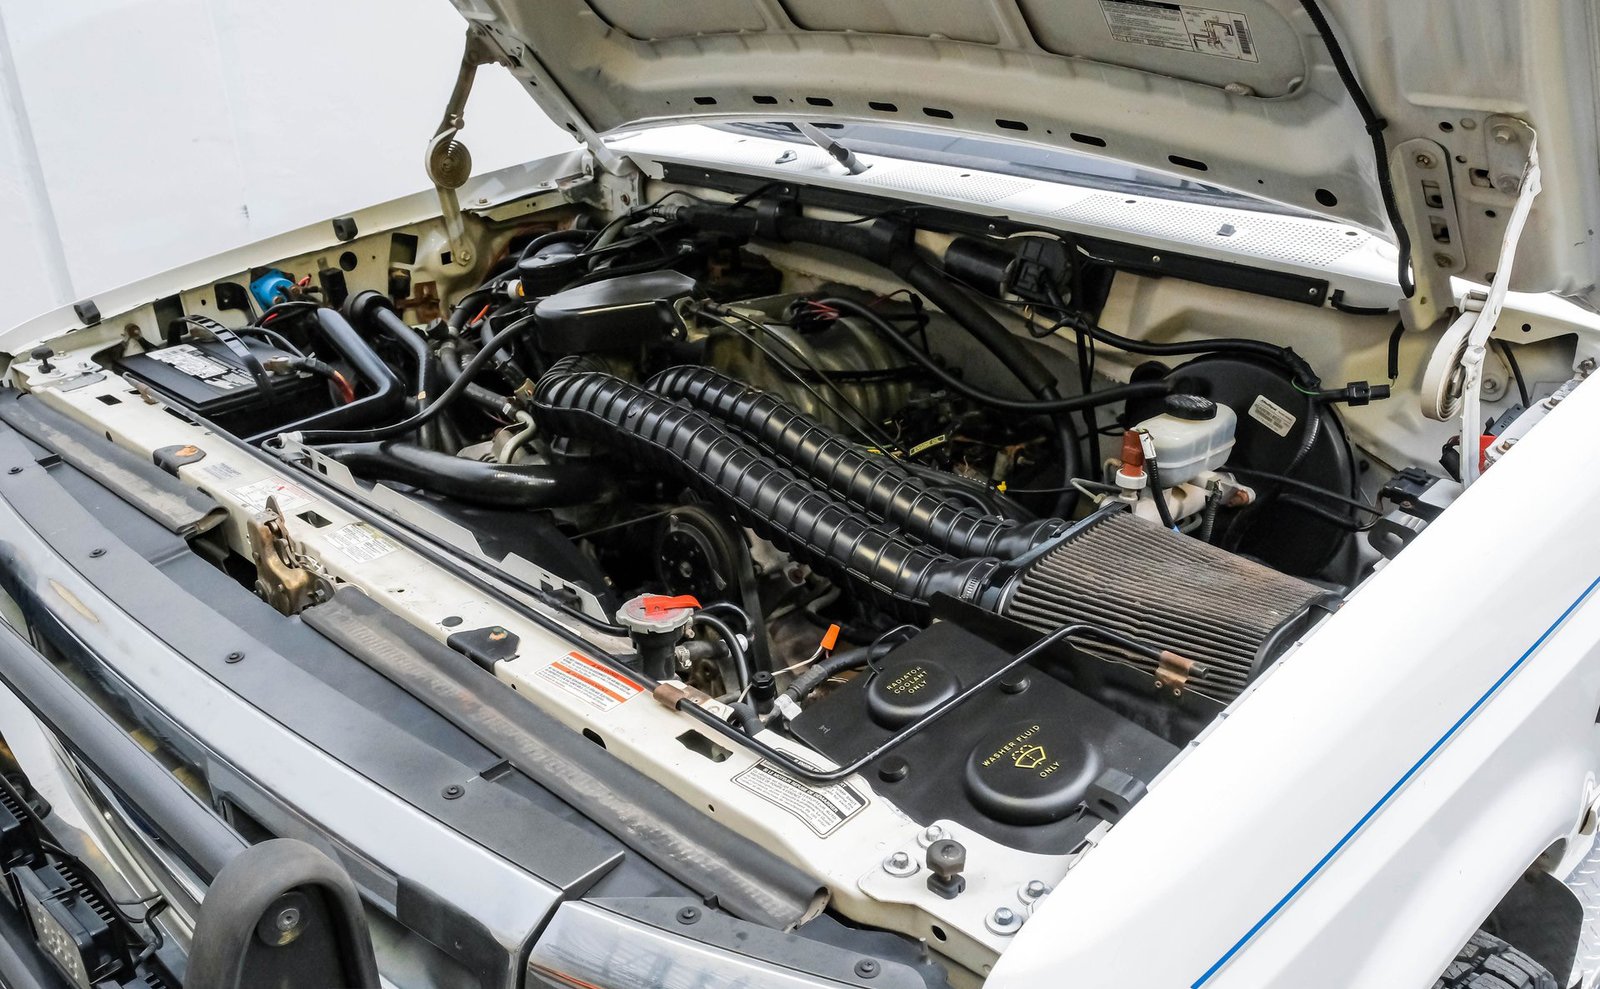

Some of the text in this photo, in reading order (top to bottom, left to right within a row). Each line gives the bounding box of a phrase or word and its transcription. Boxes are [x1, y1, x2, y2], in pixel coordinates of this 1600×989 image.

[886, 666, 922, 690] RADIATOR
[894, 670, 927, 694] COOLANT
[908, 680, 927, 693] ONLY
[982, 725, 1040, 767] WASHER FLUID
[1039, 761, 1060, 778] ONLY
